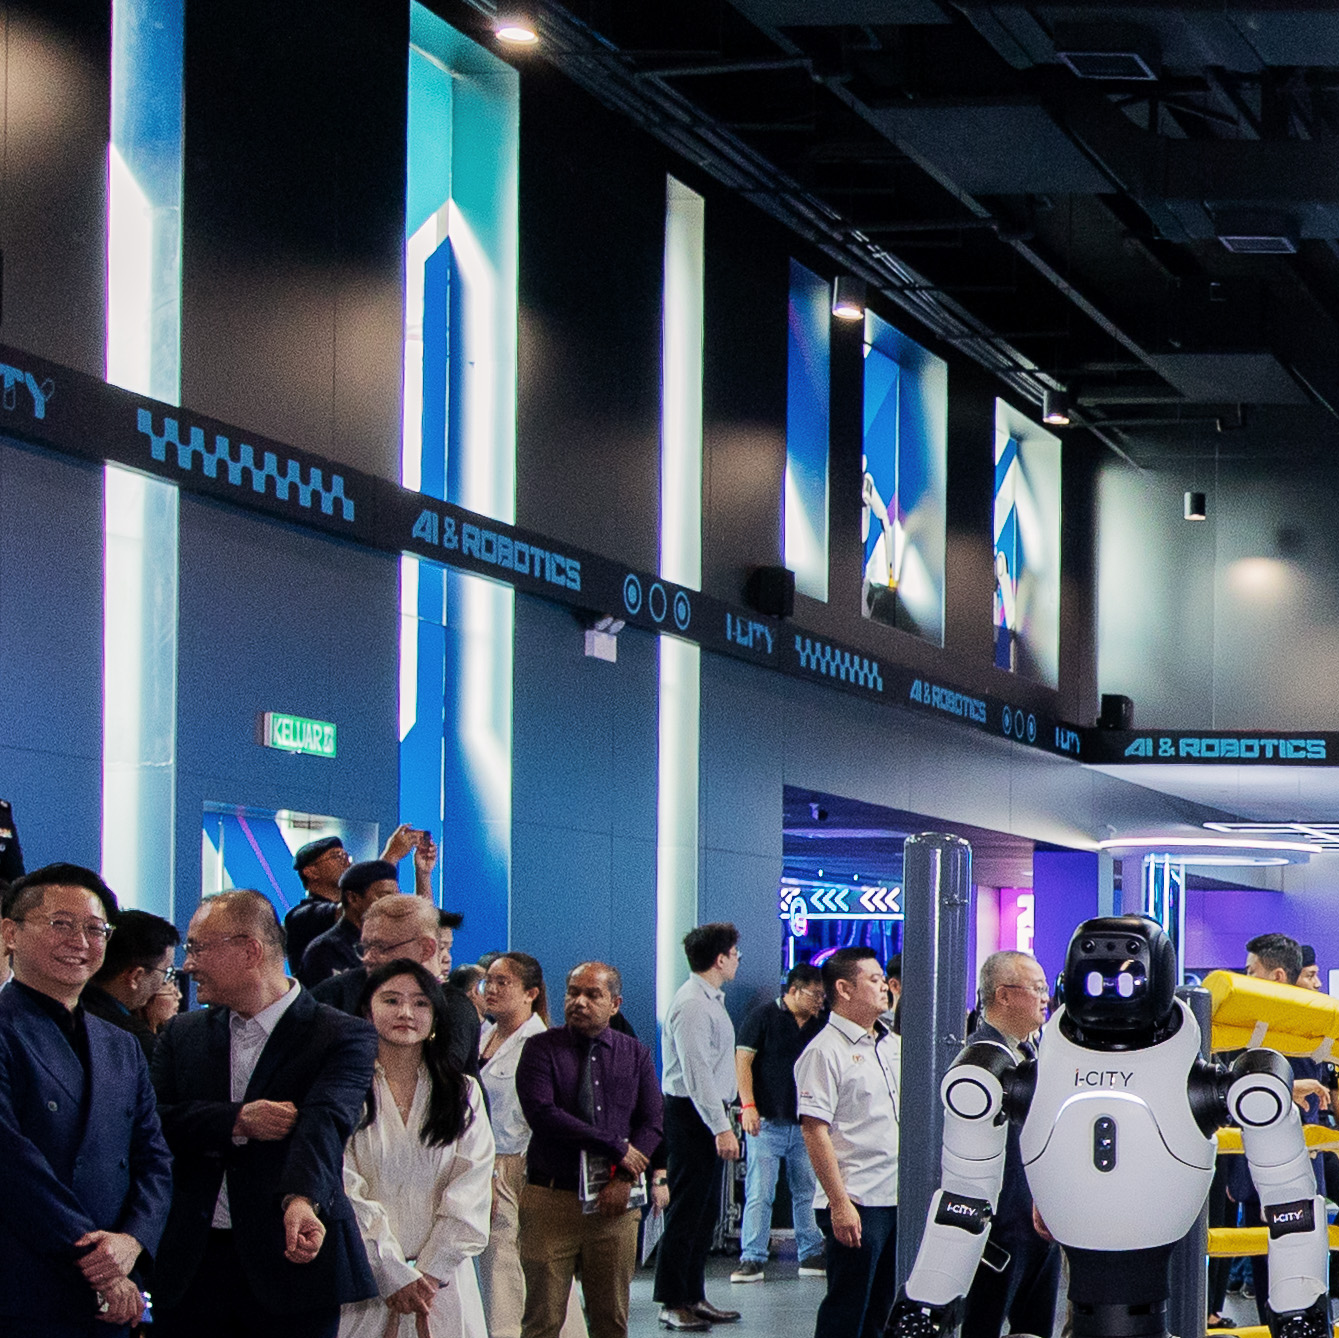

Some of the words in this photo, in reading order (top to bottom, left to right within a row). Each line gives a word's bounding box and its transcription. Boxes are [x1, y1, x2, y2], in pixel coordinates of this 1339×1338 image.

[412, 509, 439, 545] AI
[443, 517, 458, 549] &
[462, 523, 581, 592] ROBOTICS
[909, 679, 922, 703] AI
[932, 685, 987, 724] ROBOTICS
[273, 718, 322, 751] KELUAR
[1124, 738, 1153, 757] AI
[1158, 738, 1175, 757] &
[1179, 738, 1326, 759] ROBOTICS
